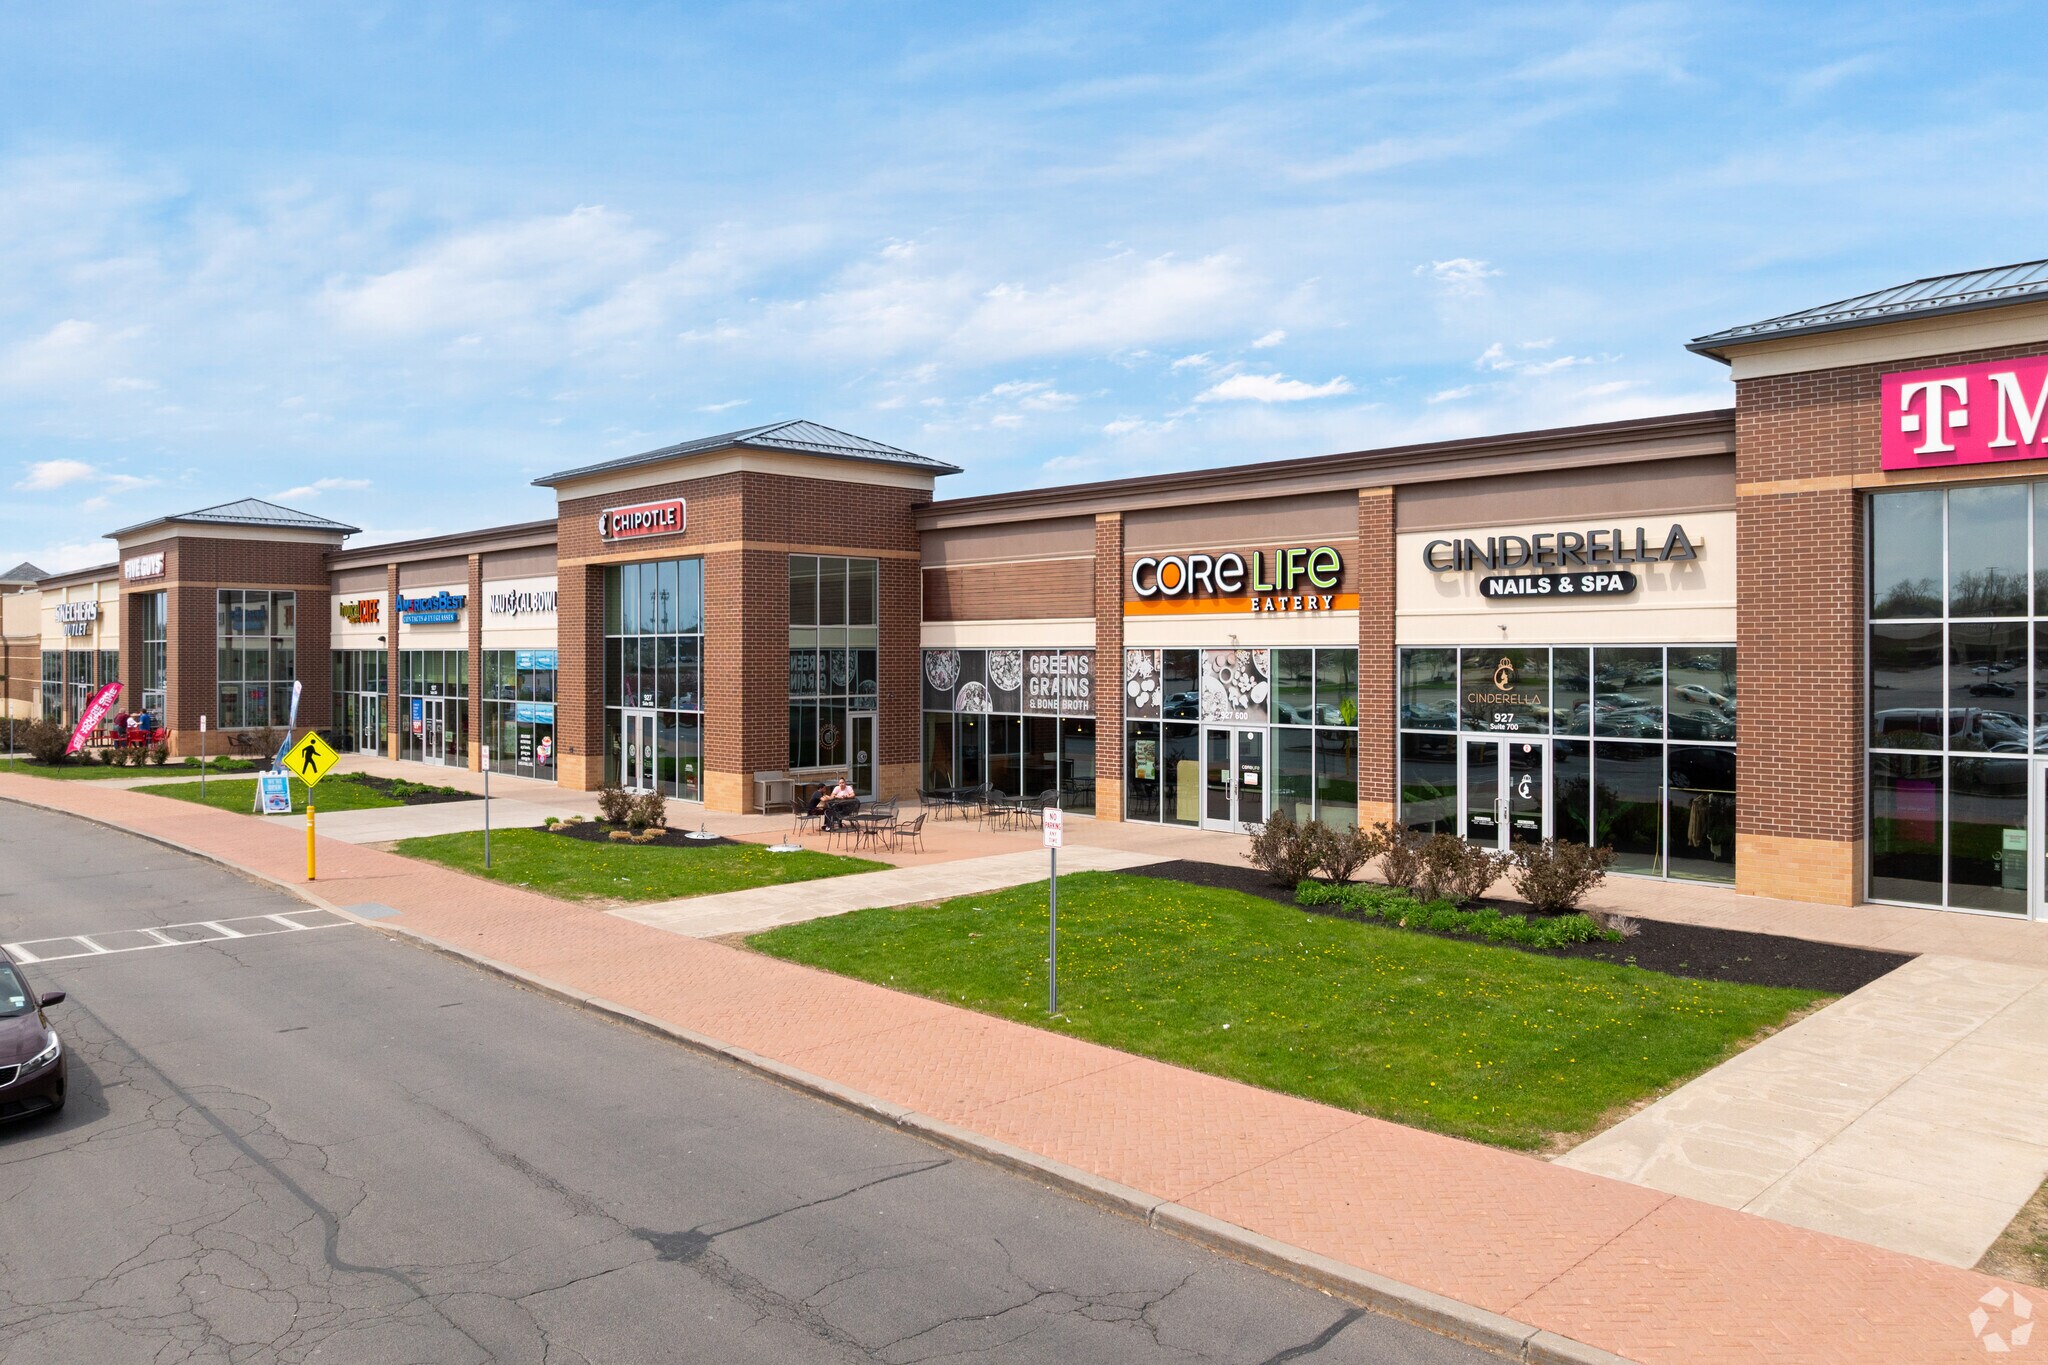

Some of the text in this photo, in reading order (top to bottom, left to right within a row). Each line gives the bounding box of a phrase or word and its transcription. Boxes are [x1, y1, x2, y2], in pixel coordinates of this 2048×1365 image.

[613, 508, 676, 531] CHIPOTLE
[1422, 524, 1698, 572] CINDERELLA
[124, 554, 164, 579] FIVE GUYS
[1489, 574, 1624, 596] NAILS & SPA
[56, 601, 98, 622] SKECHERS
[360, 600, 379, 622] CAFE
[1251, 595, 1334, 612] EATERY
[64, 622, 88, 636] OUTLET
[1030, 656, 1088, 674] GREENS
[1030, 677, 1089, 697] GRAINS
[1030, 698, 1088, 710] & BONE BROTH
[1468, 694, 1542, 704] CINDERELLA
[1235, 712, 1248, 720] 600
[1494, 713, 1514, 722] 927
[1044, 822, 1061, 830] PARKING
